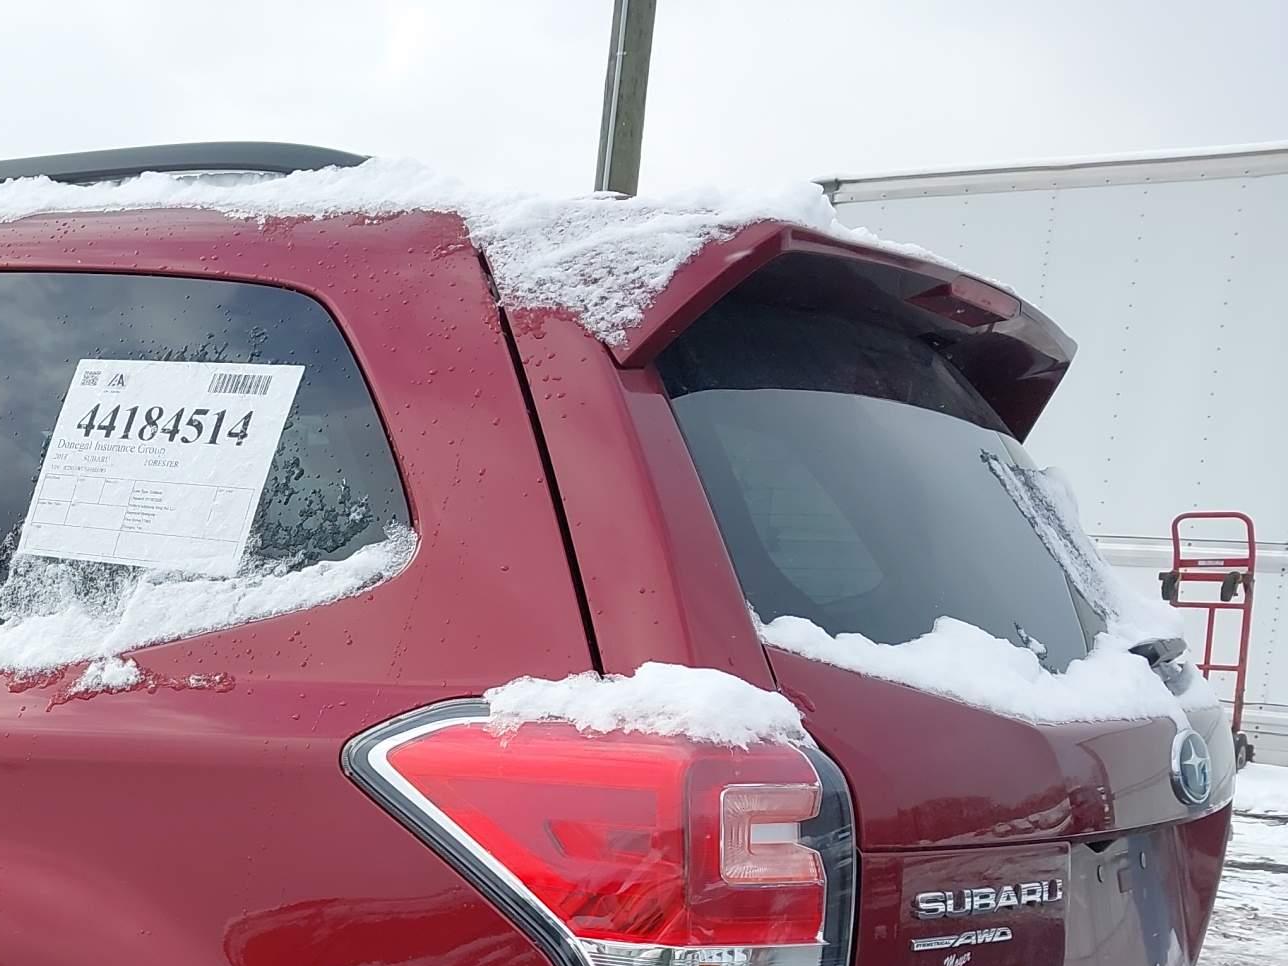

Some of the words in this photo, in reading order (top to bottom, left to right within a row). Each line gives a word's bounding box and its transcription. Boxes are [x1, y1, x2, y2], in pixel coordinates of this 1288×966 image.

[76, 403, 255, 447] 44184514
[57, 438, 93, 452] Donegal
[94, 440, 136, 454] Insurance
[137, 443, 166, 458] Group
[915, 878, 1063, 920] SUBARU
[951, 927, 1013, 948] AWD
